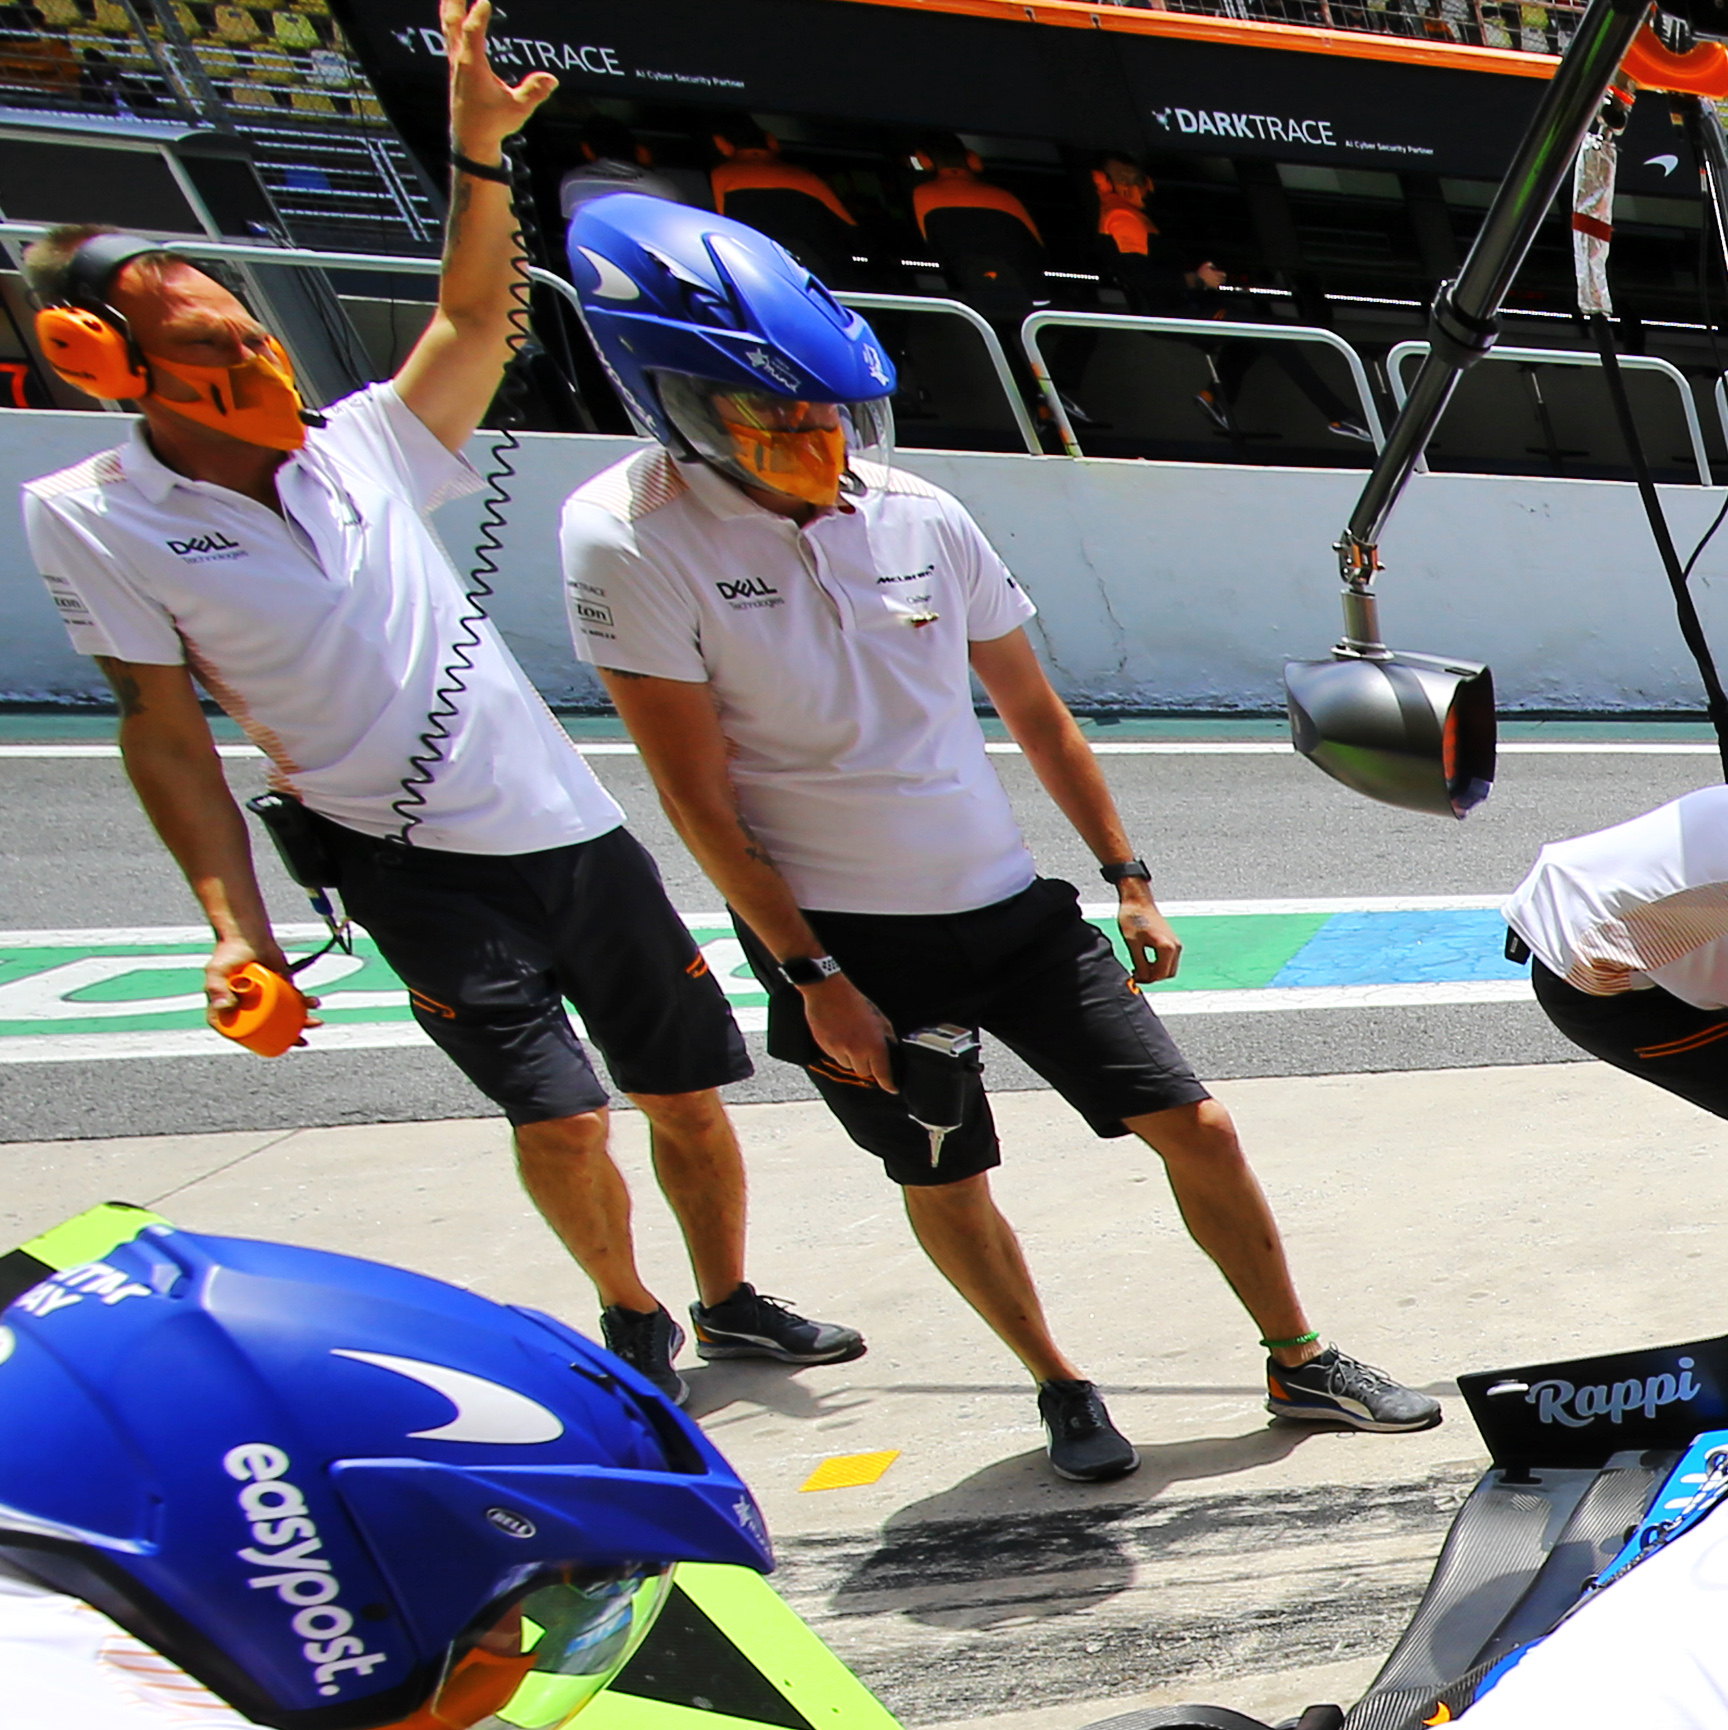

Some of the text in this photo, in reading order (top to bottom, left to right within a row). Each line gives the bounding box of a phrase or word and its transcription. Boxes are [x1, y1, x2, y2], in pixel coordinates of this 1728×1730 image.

[647, 70, 674, 81] Cyber
[675, 73, 712, 87] Security
[713, 76, 745, 89] Partner
[1174, 108, 1337, 147] DARKTRACE
[166, 531, 240, 556] DELL
[715, 577, 777, 600] DELL
[1524, 1356, 1702, 1428] Rappi
[491, 1511, 529, 1535] BELL
[222, 1442, 387, 1697] easypost.
